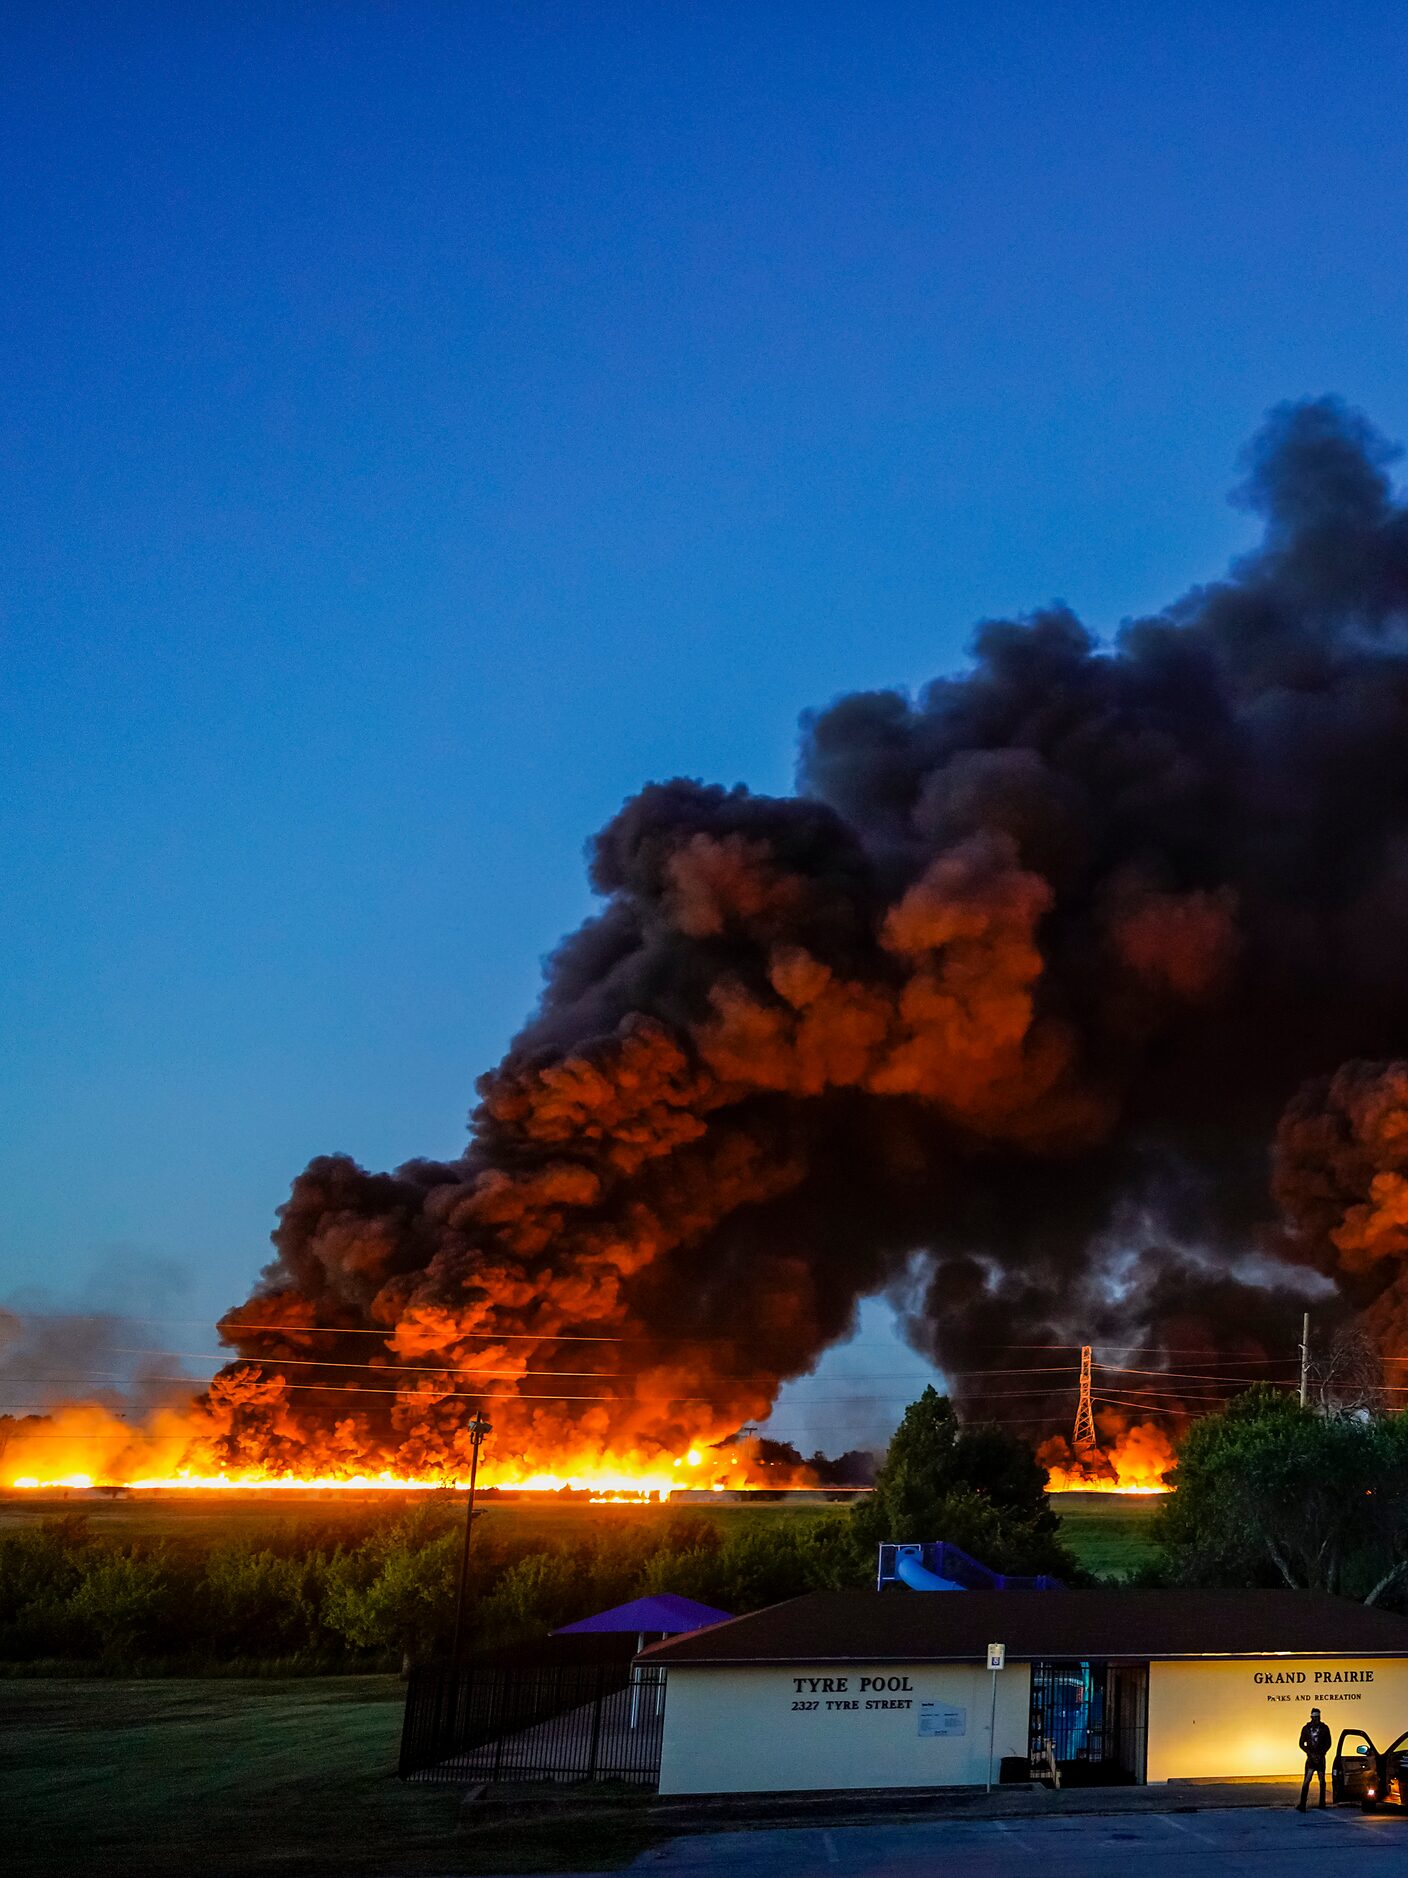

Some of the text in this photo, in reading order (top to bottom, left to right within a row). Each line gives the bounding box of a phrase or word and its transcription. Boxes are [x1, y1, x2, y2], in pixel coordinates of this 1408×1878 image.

[1253, 1671, 1374, 1684] GRAND PRAIRIE
[793, 1677, 913, 1693] TYRE POOL
[791, 1701, 819, 1711] 2327
[826, 1701, 859, 1710] TYRE
[865, 1700, 913, 1710] STREET
